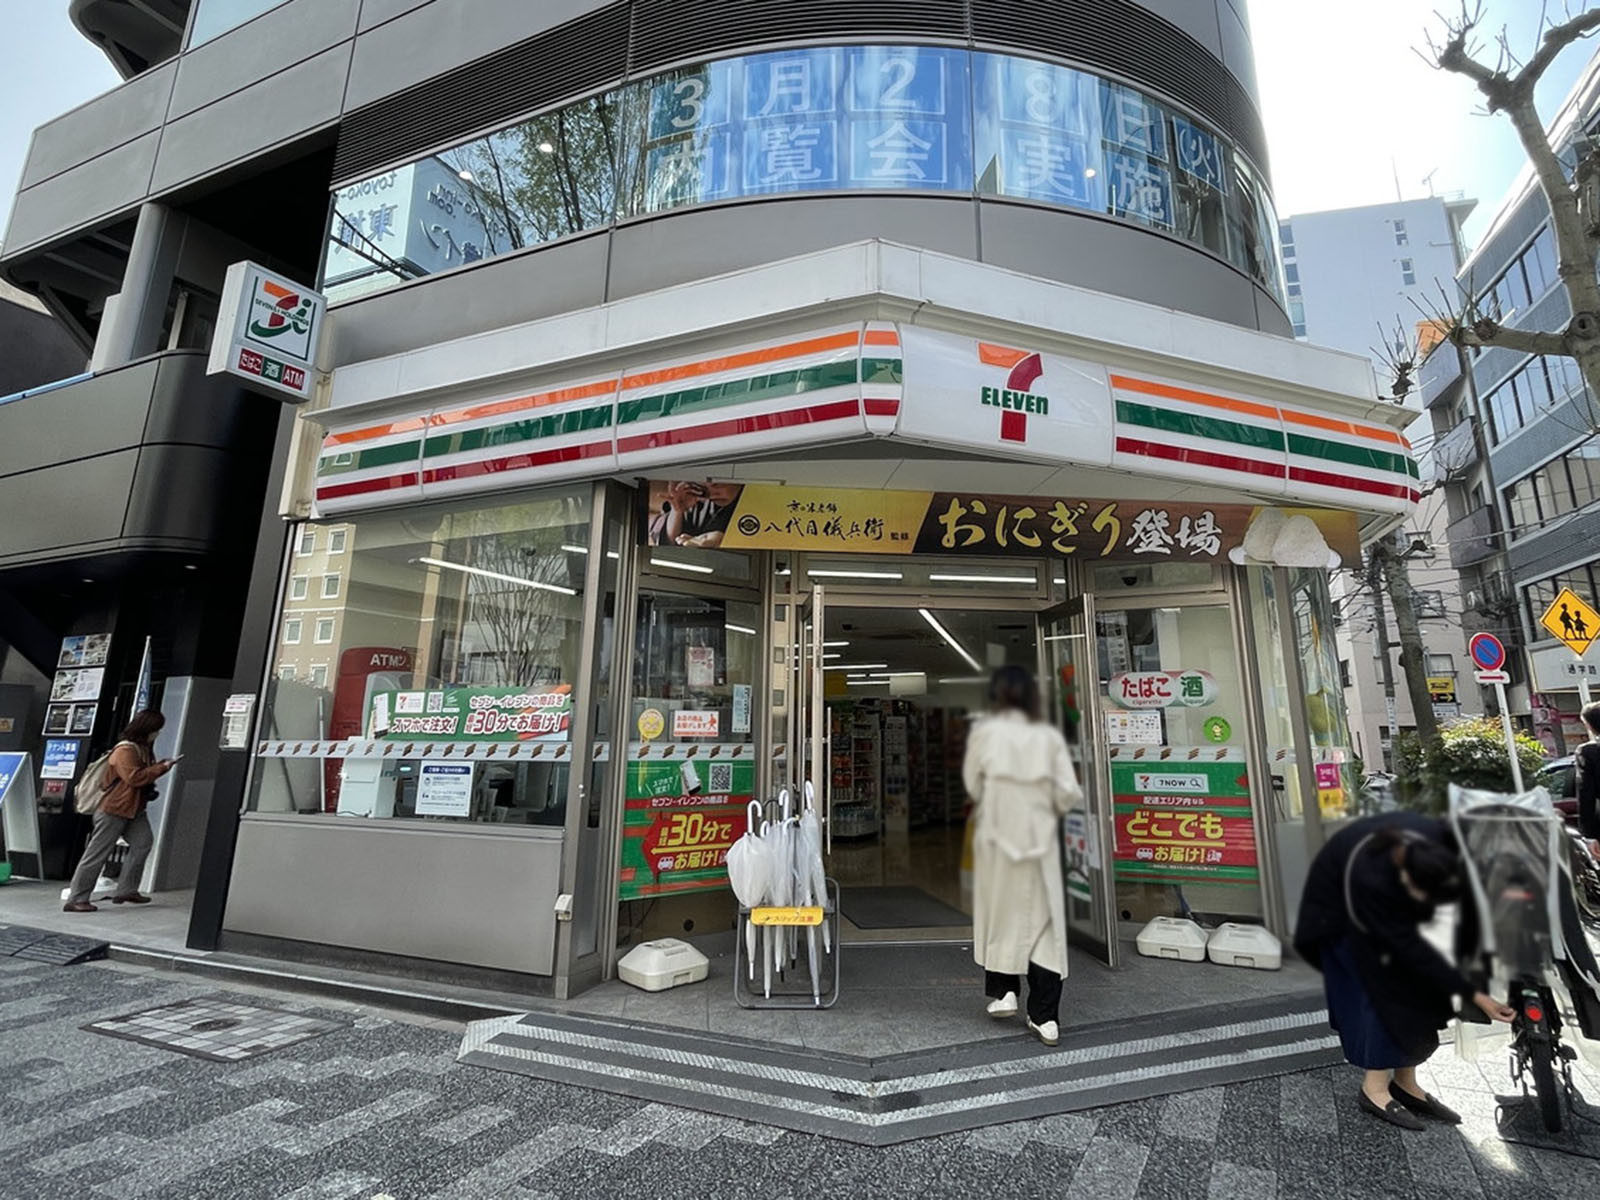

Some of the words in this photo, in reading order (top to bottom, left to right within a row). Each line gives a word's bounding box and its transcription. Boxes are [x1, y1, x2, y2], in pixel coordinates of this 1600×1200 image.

[264, 361, 281, 379] 酒
[283, 369, 303, 387] ATM
[938, 495, 1223, 557] おにぎり登場
[369, 653, 398, 667] ATM
[1121, 676, 1172, 698] たばこ
[1180, 676, 1204, 697] 酒
[1159, 779, 1187, 787] 7NOW
[1126, 810, 1224, 839] どこでも
[674, 851, 718, 870] お届け!
[1154, 846, 1206, 863] お届け!
